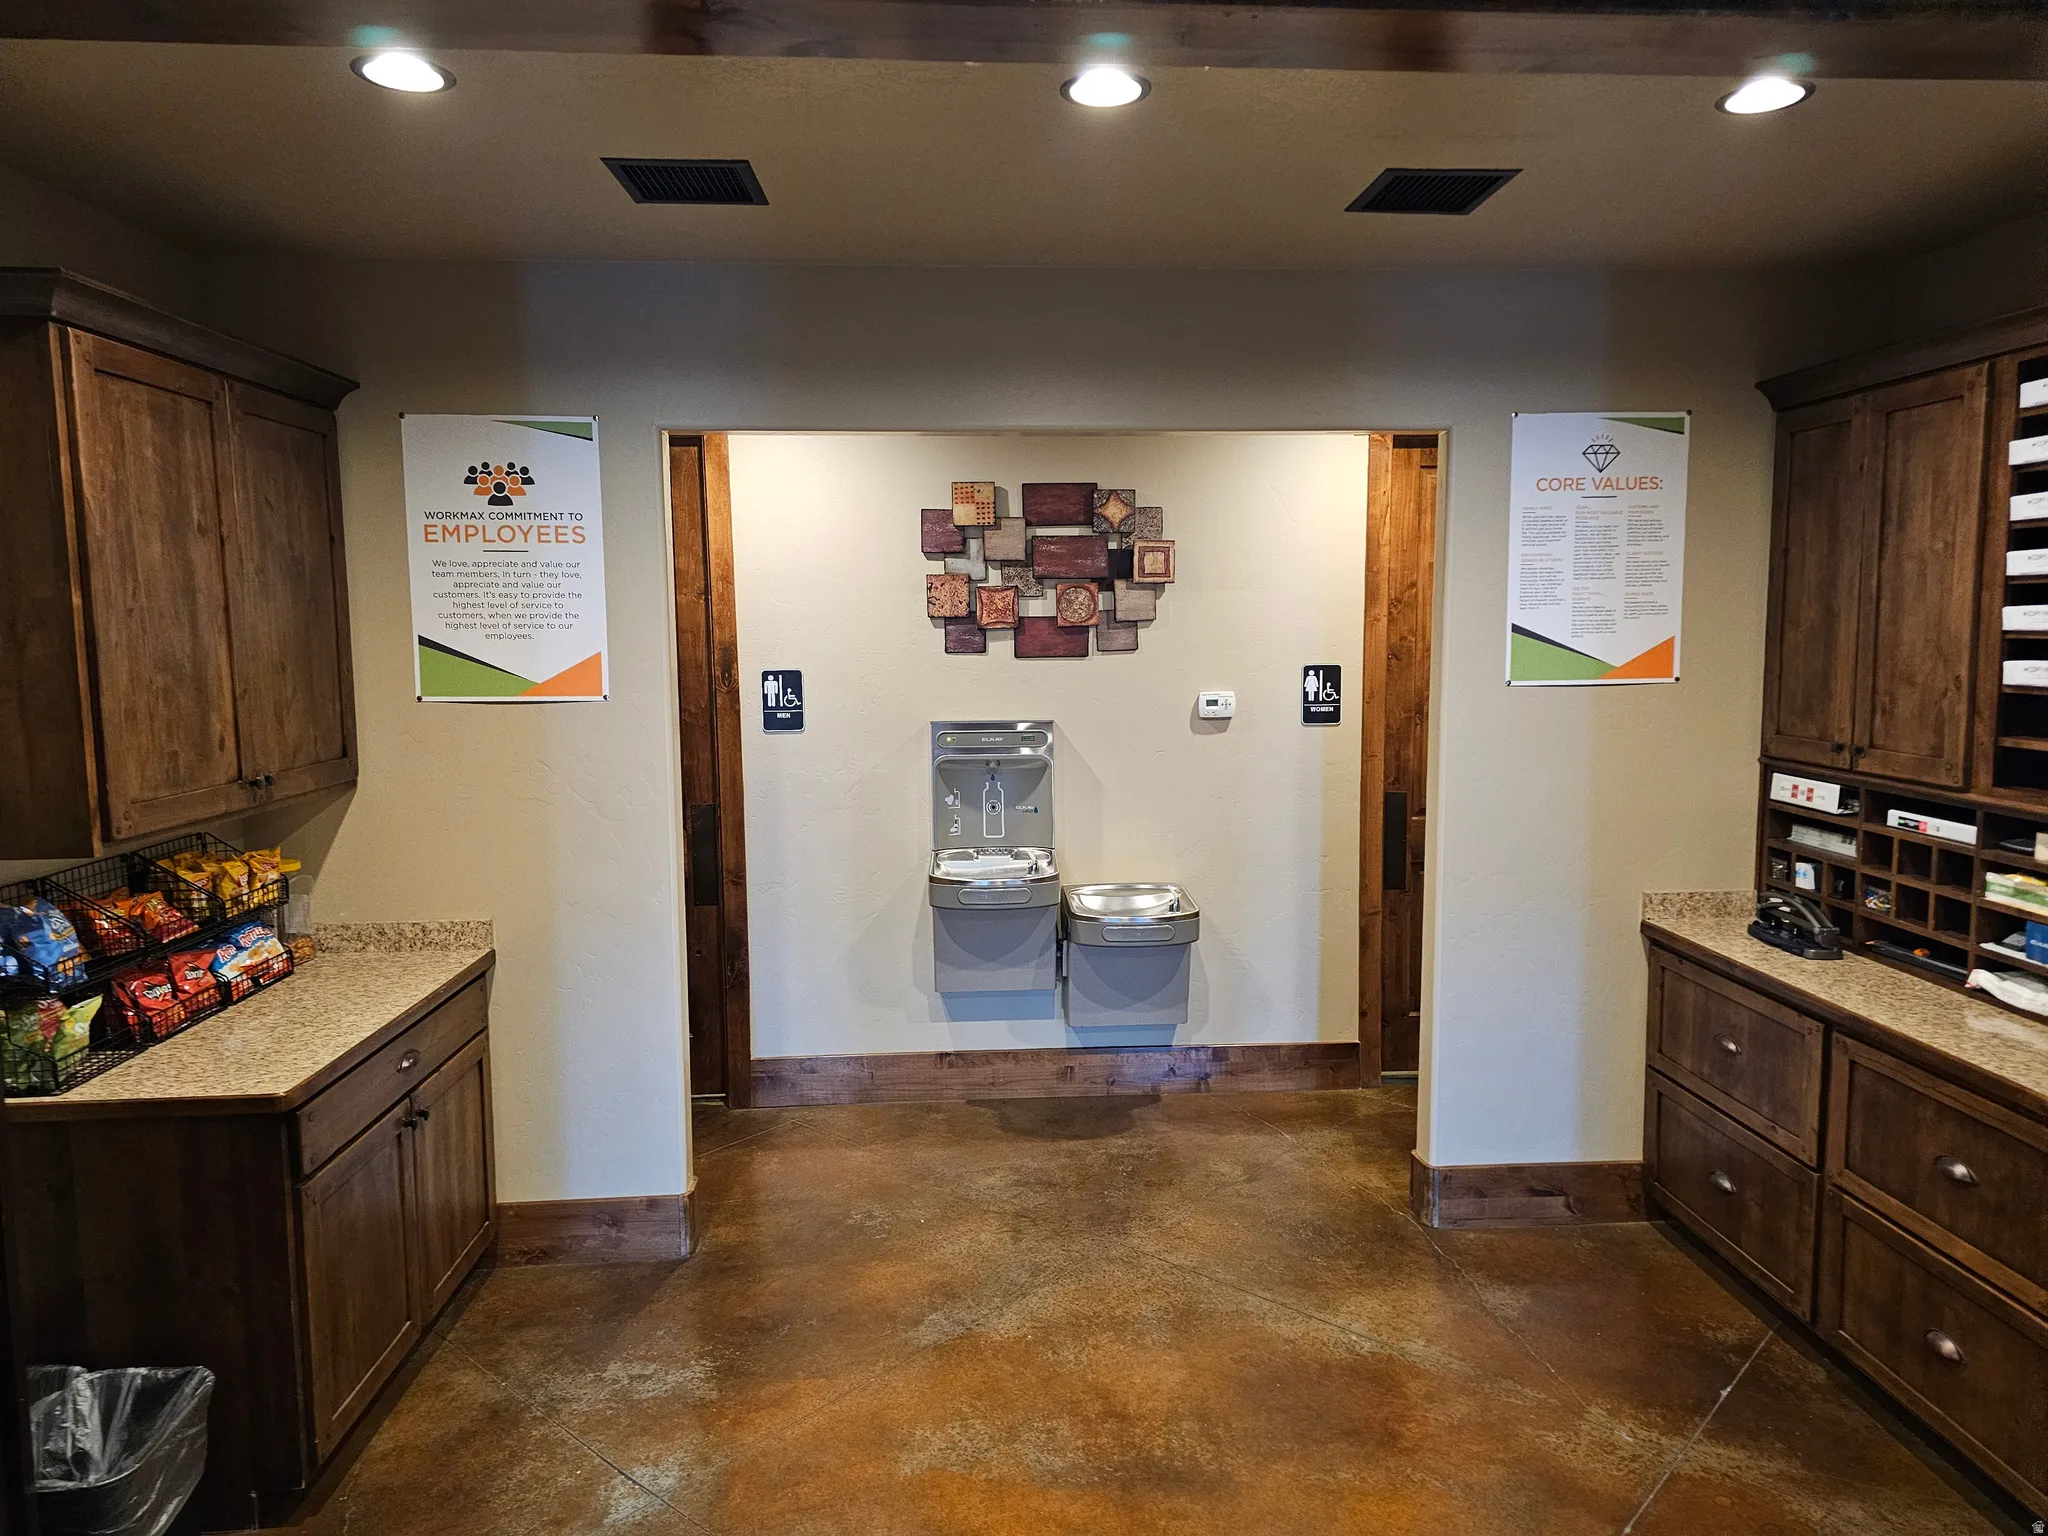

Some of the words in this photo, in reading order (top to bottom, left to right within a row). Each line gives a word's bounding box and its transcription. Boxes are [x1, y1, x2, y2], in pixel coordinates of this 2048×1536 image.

[1536, 477, 1586, 492] CORE
[1591, 476, 1663, 491] VALUES:
[424, 511, 485, 520] WORKMAX
[488, 511, 565, 521] COMMITMENT
[568, 512, 583, 521] TO
[424, 524, 586, 544] EMPLOYEES
[432, 559, 447, 568] We
[449, 560, 470, 569] love,
[471, 560, 521, 570] appreciate
[520, 560, 538, 568] and
[539, 560, 563, 568] value
[539, 571, 559, 580] they
[561, 571, 582, 580] love,
[453, 581, 500, 591] appreciate
[502, 581, 519, 589] and
[520, 581, 544, 589] value
[498, 592, 518, 601] easy
[532, 591, 566, 600] provide
[568, 591, 583, 599] the
[452, 601, 485, 611] highest
[487, 601, 507, 609] level
[509, 601, 518, 609] of
[438, 612, 486, 620] customers,
[488, 611, 512, 619] when
[529, 611, 563, 621] provide
[565, 611, 580, 620] the
[445, 622, 477, 631] highest
[513, 622, 544, 630] service
[485, 632, 534, 640] employees.
